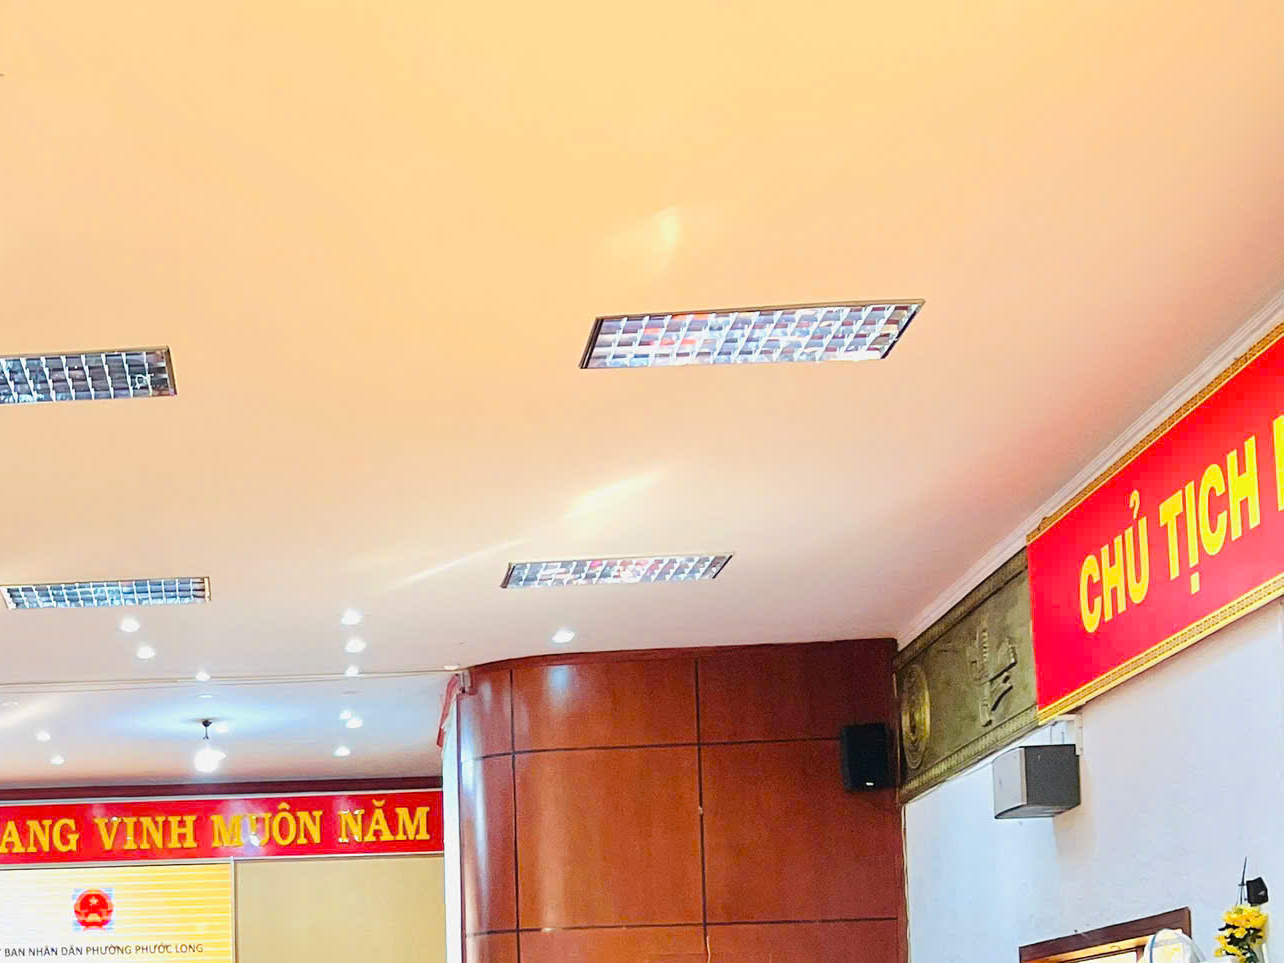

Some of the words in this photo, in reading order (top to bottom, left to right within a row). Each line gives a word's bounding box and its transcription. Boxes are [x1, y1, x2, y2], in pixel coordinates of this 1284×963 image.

[1079, 489, 1150, 634] CHỦ
[1159, 434, 1261, 595] TỊCH
[93, 815, 197, 851] VINH
[212, 802, 323, 848] MUÔN
[338, 799, 430, 843] NĂM
[4, 947, 26, 958] BAN
[28, 946, 58, 957] NHÂN
[61, 944, 83, 956] DÂN
[85, 944, 132, 956] PHƯỜNG
[135, 943, 173, 955] PHƯỚC
[175, 943, 204, 954] LONG
